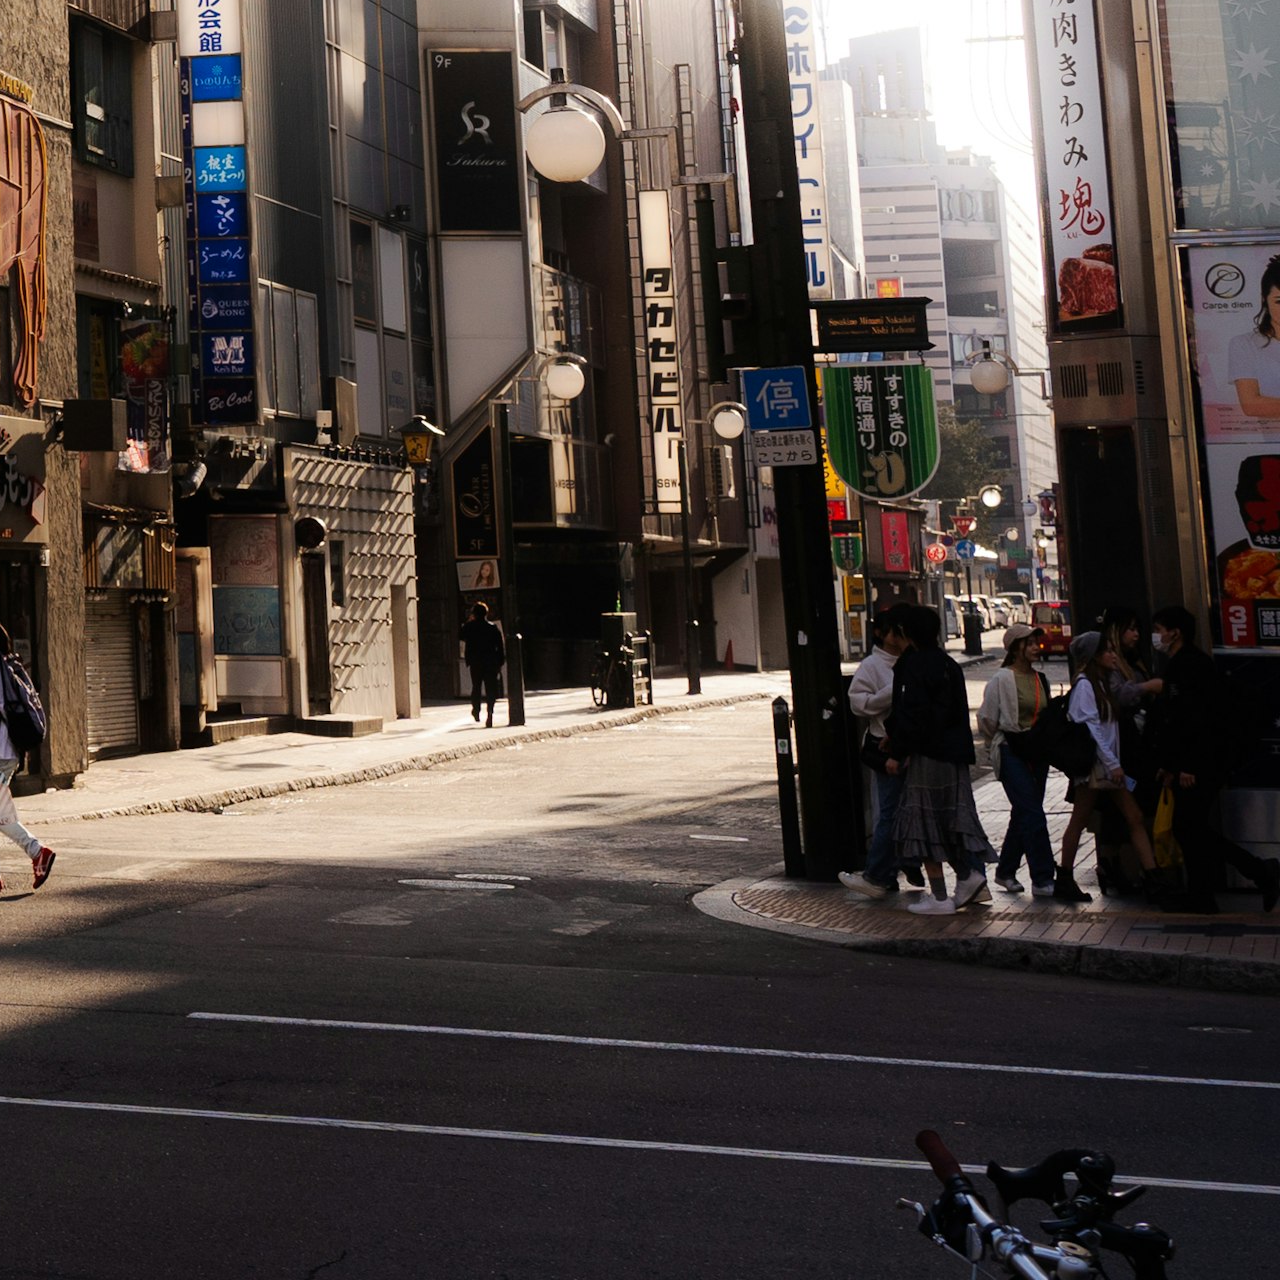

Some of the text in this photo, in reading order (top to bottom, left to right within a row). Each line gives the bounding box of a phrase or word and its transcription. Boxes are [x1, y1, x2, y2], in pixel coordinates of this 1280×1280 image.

[434, 53, 452, 69] 9F
[194, 75, 241, 88] いのりんち
[205, 155, 236, 169] 根室
[445, 152, 508, 168] Sakura
[197, 169, 246, 185] うにまつり
[1059, 176, 1106, 237] 塊
[200, 246, 245, 262] らーめん
[218, 300, 250, 308] QUEEN
[218, 308, 246, 316] KONG
[1202, 301, 1253, 310] Carpe diem
[646, 267, 682, 433] タカセビル
[208, 389, 254, 411] Be Cool
[754, 377, 800, 419] 停
[852, 374, 877, 451] 新宿通り
[883, 373, 908, 448] すすきの
[757, 449, 814, 464] ここから
[657, 478, 682, 489] S6W
[469, 537, 485, 551] 5F
[216, 566, 229, 582] 5F
[221, 612, 276, 634] AQUA
[1228, 605, 1248, 643] 3F
[218, 635, 231, 652] 2F
